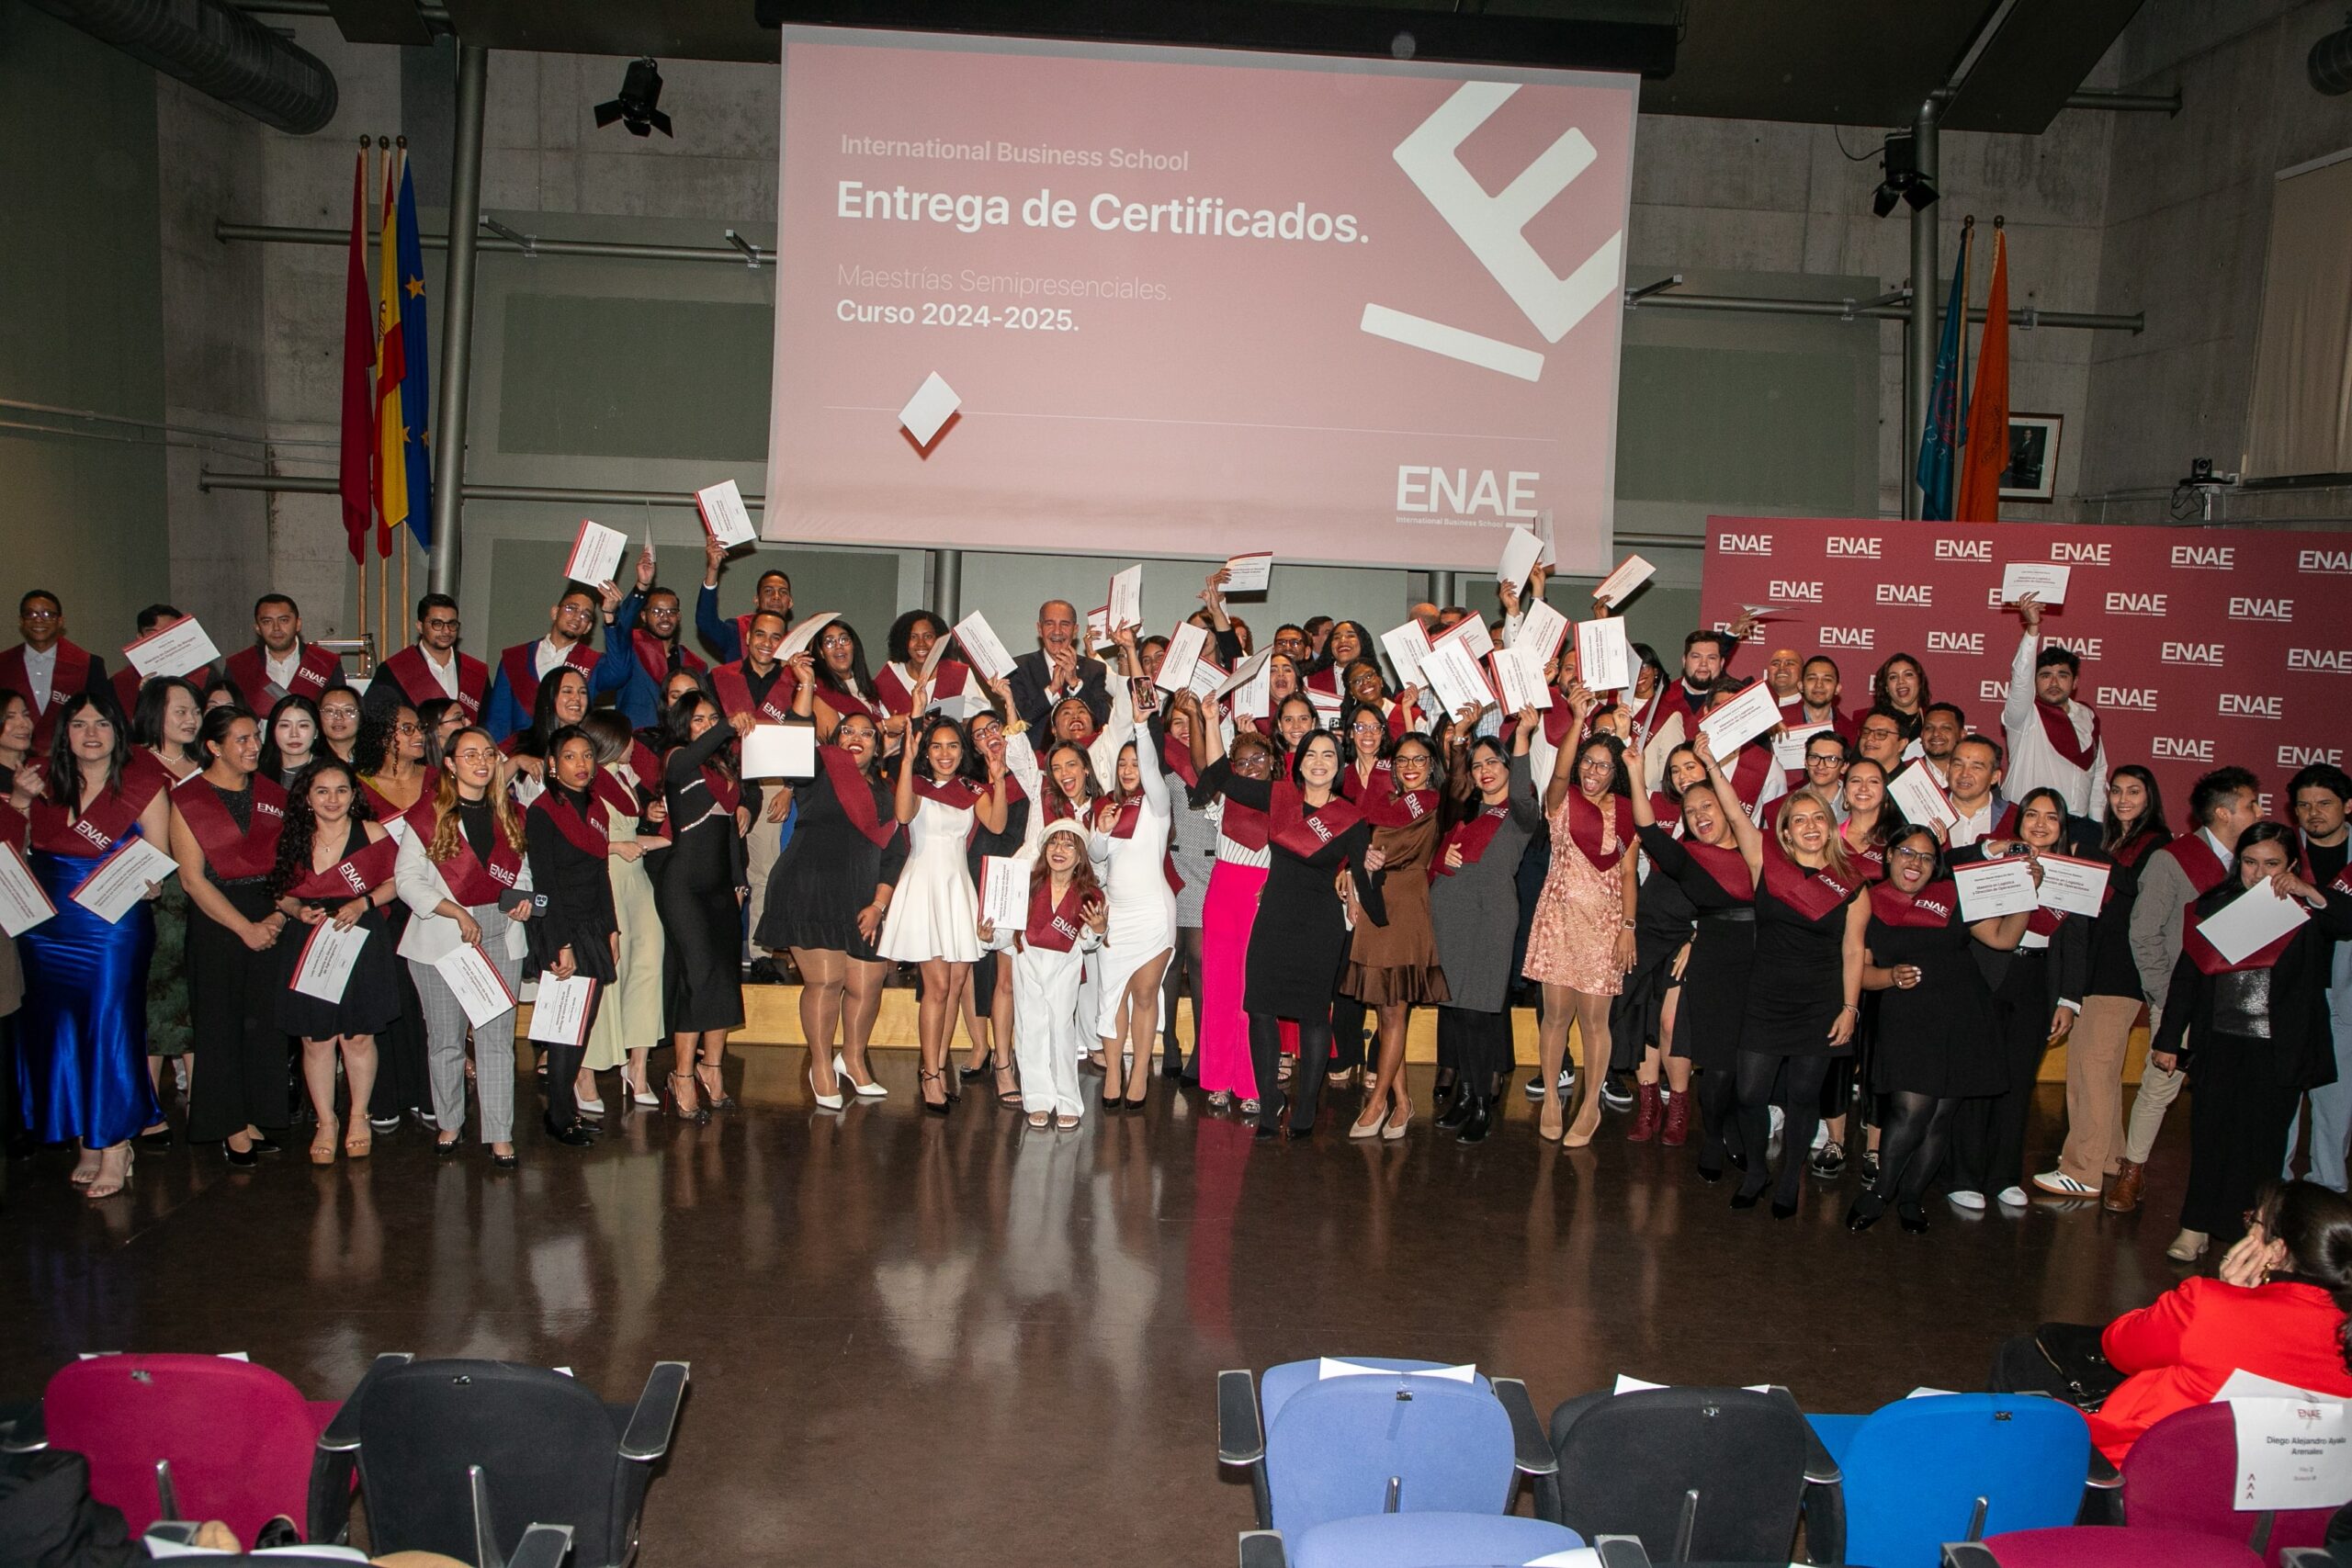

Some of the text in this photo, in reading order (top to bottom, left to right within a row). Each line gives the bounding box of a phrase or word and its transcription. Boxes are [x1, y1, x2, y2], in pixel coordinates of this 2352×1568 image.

[842, 134, 1189, 171] International Business School
[838, 181, 1369, 243] Entrega de Certificados.
[837, 264, 1172, 302] Maestrías Semipresenciales.
[836, 299, 1080, 332] Curso 2024-2025.
[1396, 465, 1540, 518] ENAE
[1396, 516, 1504, 528] International Business School
[1719, 534, 1773, 551] ENAE
[1826, 536, 1882, 555] ENAE
[1935, 539, 1993, 558] ENAE
[2051, 542, 2112, 562] ENAE
[2171, 546, 2235, 566] ENAE
[2299, 549, 2352, 570] ENA
[1770, 581, 1824, 599] ENAE
[1876, 584, 1933, 603] ENAE
[2105, 592, 2168, 613] ENAE
[2229, 597, 2294, 618] ENAE
[1819, 626, 1875, 645] ENAE
[1928, 631, 1985, 650] ENAE
[2161, 641, 2225, 662] ENAE
[2287, 648, 2352, 670] ENAE
[300, 667, 328, 687] ENAE
[459, 692, 481, 711] ENAE
[2097, 686, 2158, 707] ENAE
[2219, 694, 2283, 715] ENAE
[2152, 737, 2215, 758] ENAE
[2278, 745, 2343, 768] ENAE
[1406, 793, 1424, 819] ENAE
[75, 820, 112, 850] ENAE
[1309, 816, 1332, 841] ENAE
[341, 862, 366, 895] ENAE
[490, 863, 515, 886] ENAE
[1818, 874, 1849, 897] ENAE
[1915, 899, 1950, 917] ENAE
[1052, 916, 1078, 938] ENAE
[2267, 1436, 2290, 1446] Diego
[2291, 1438, 2327, 1446] Alejandro
